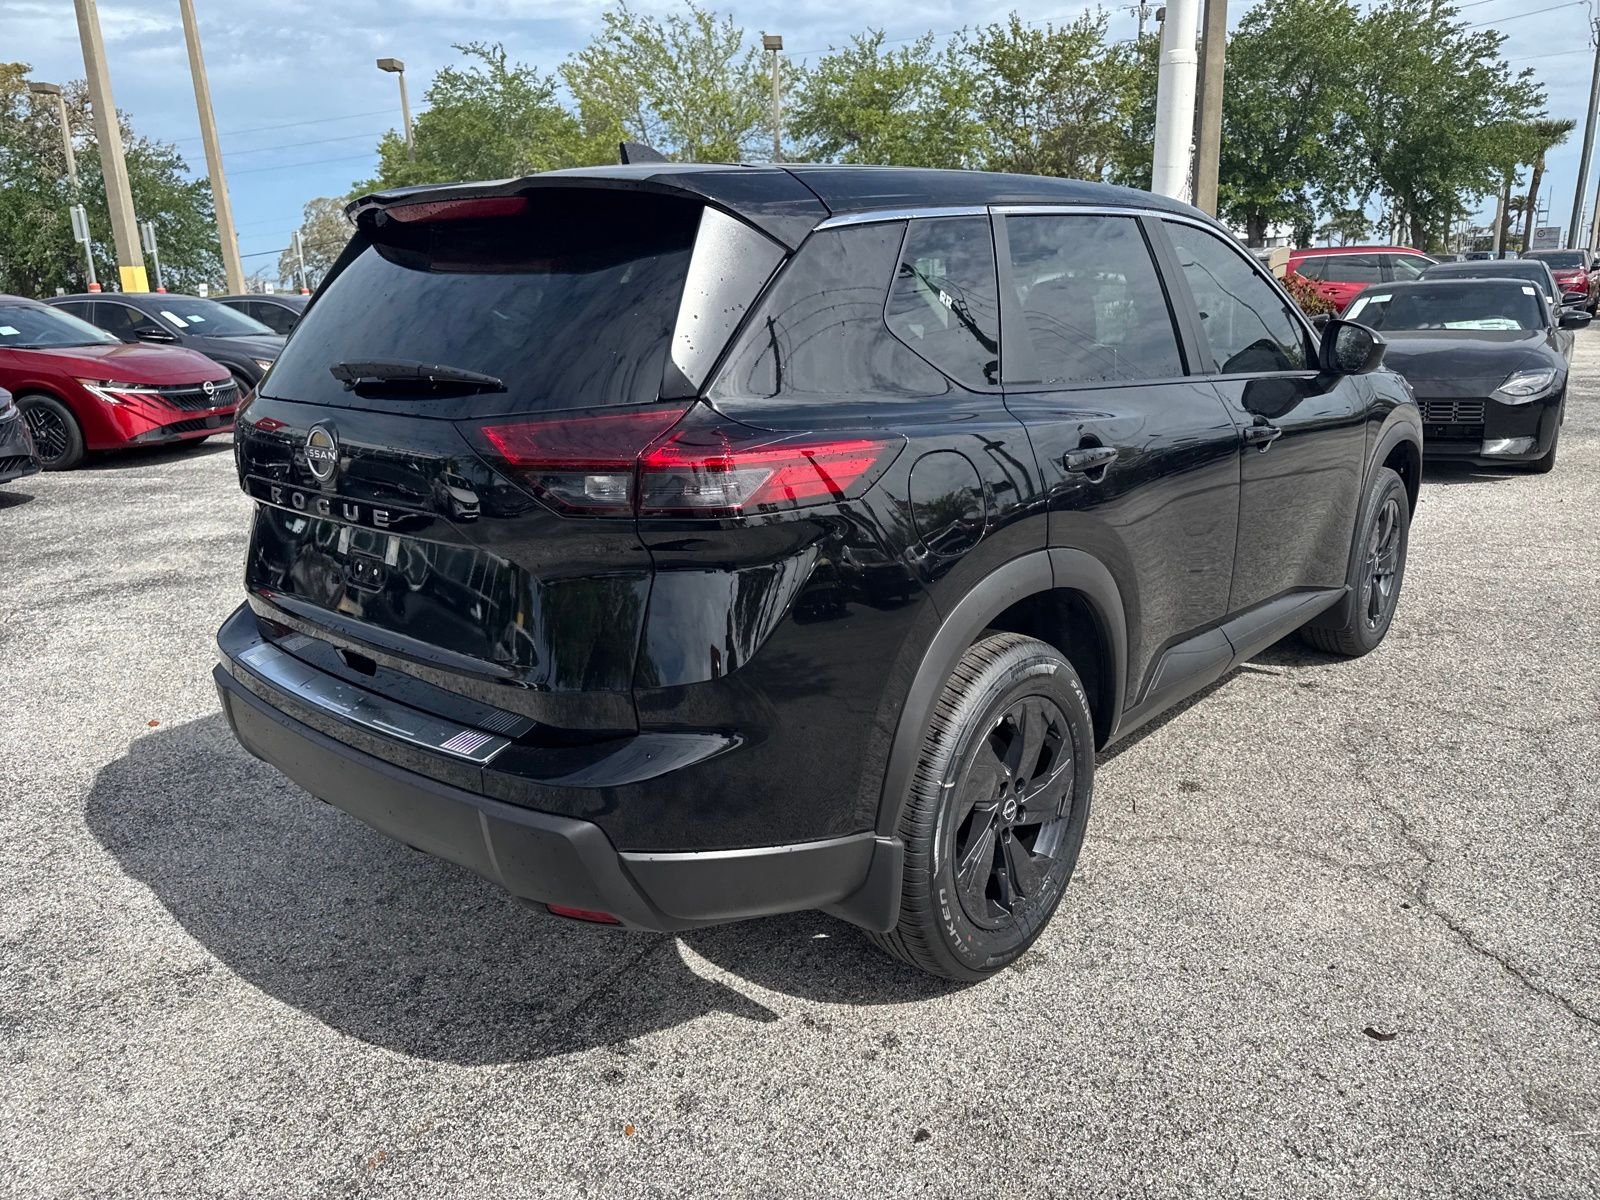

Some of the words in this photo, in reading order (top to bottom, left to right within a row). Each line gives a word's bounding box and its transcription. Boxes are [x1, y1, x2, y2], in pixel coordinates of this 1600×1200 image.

[304, 447, 336, 460] NSSAN
[270, 486, 390, 528] ROGUE
[1070, 679, 1094, 752] FALK
